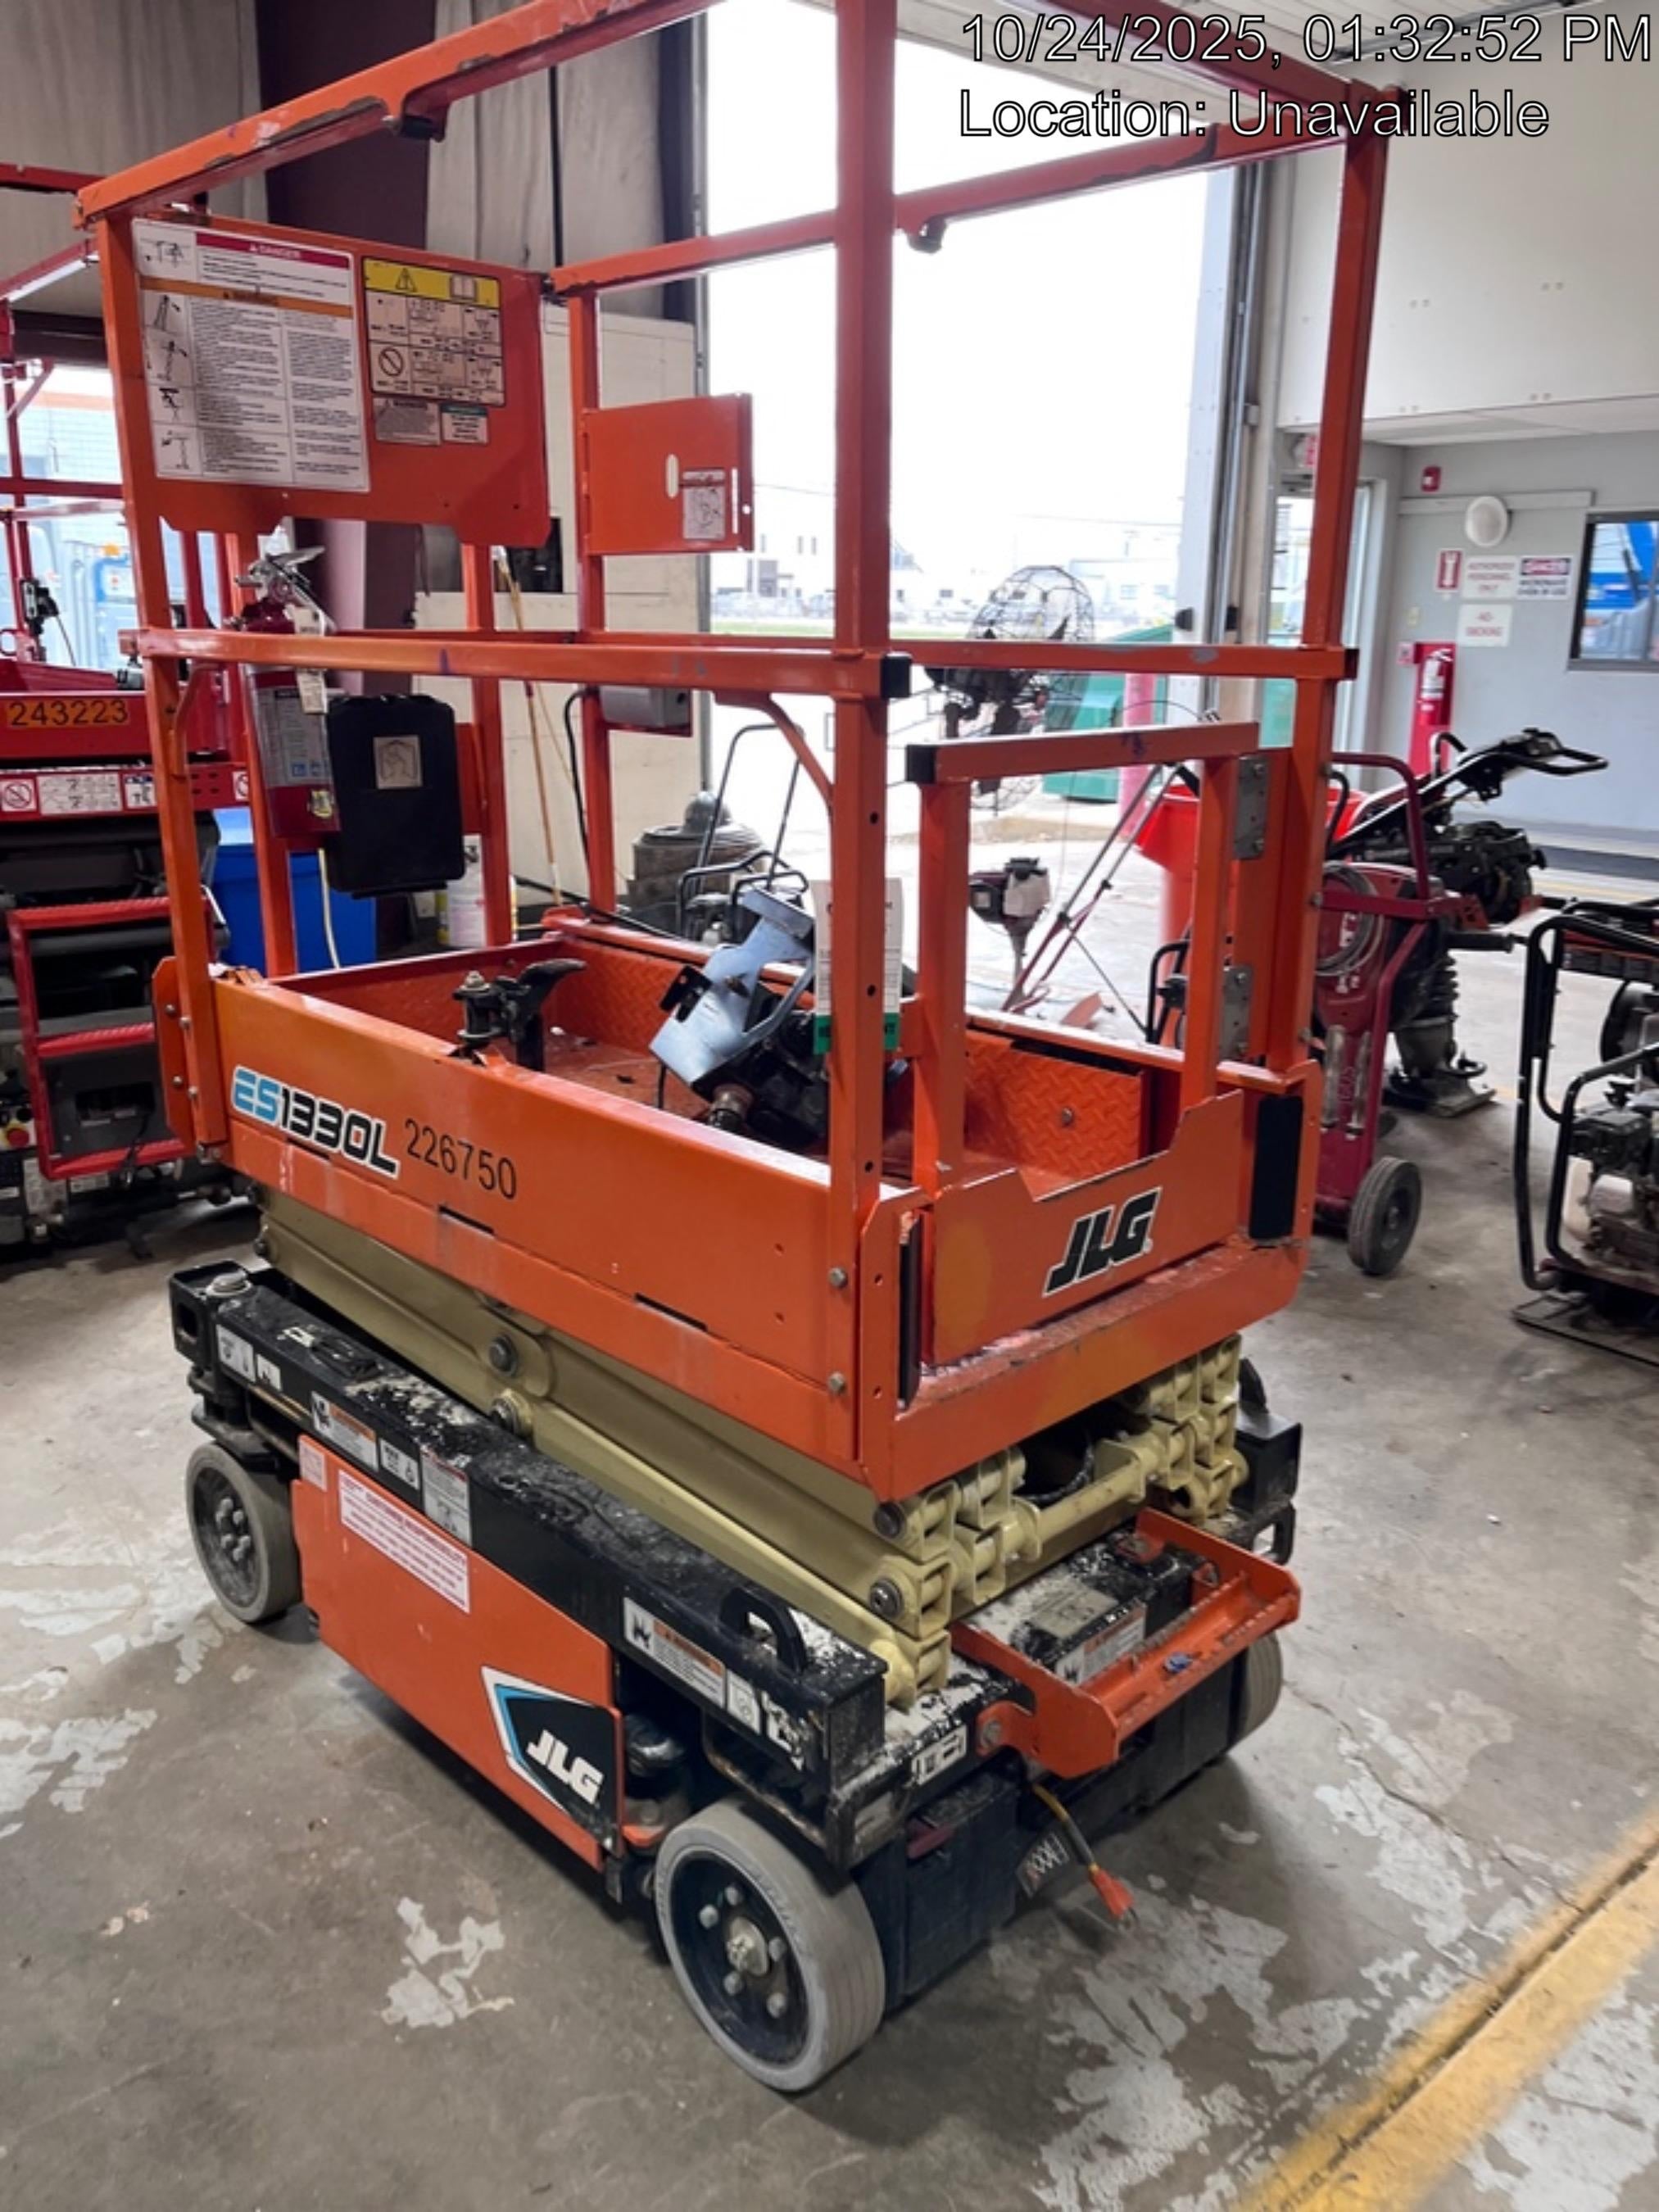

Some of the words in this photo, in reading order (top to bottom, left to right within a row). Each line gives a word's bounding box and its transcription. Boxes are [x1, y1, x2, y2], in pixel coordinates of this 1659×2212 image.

[8, 698, 129, 727] 243223
[232, 1065, 401, 1180] ES1330L
[404, 1117, 519, 1201] 226750
[1042, 1185, 1163, 1299] JLG
[526, 1729, 605, 1805] JLG
